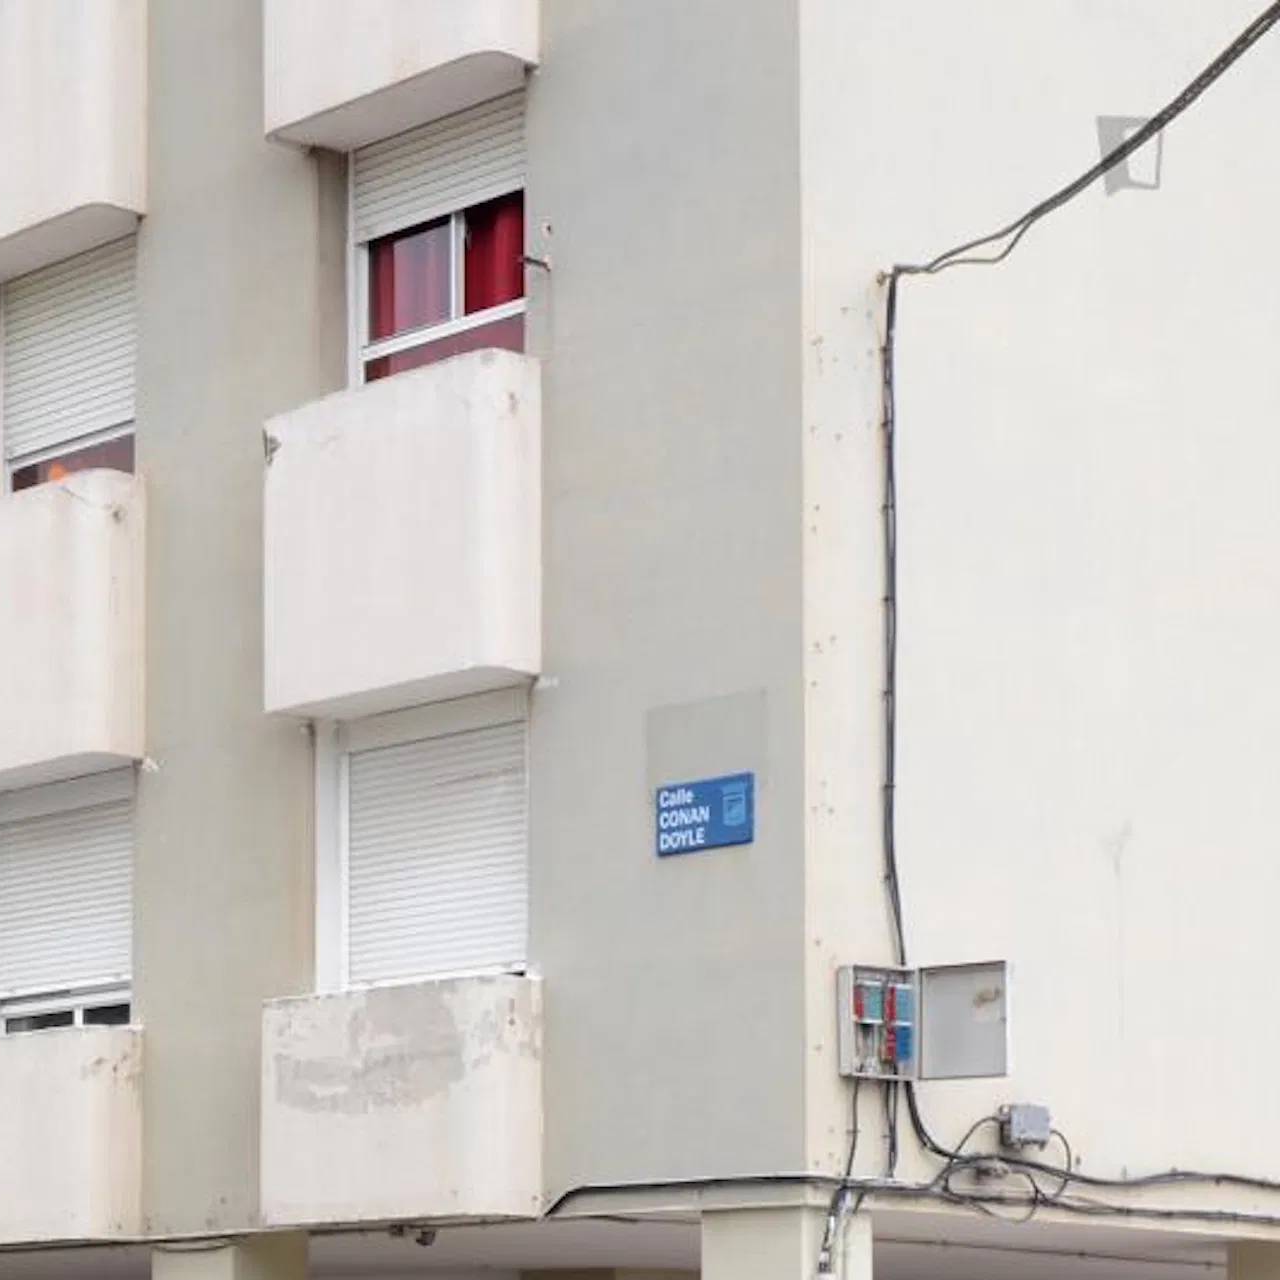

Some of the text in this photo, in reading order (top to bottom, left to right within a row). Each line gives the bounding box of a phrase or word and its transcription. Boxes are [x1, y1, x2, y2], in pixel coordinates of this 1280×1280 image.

[659, 789, 693, 808] Calle
[659, 806, 710, 829] CONAN
[660, 828, 705, 850] DOYLE
